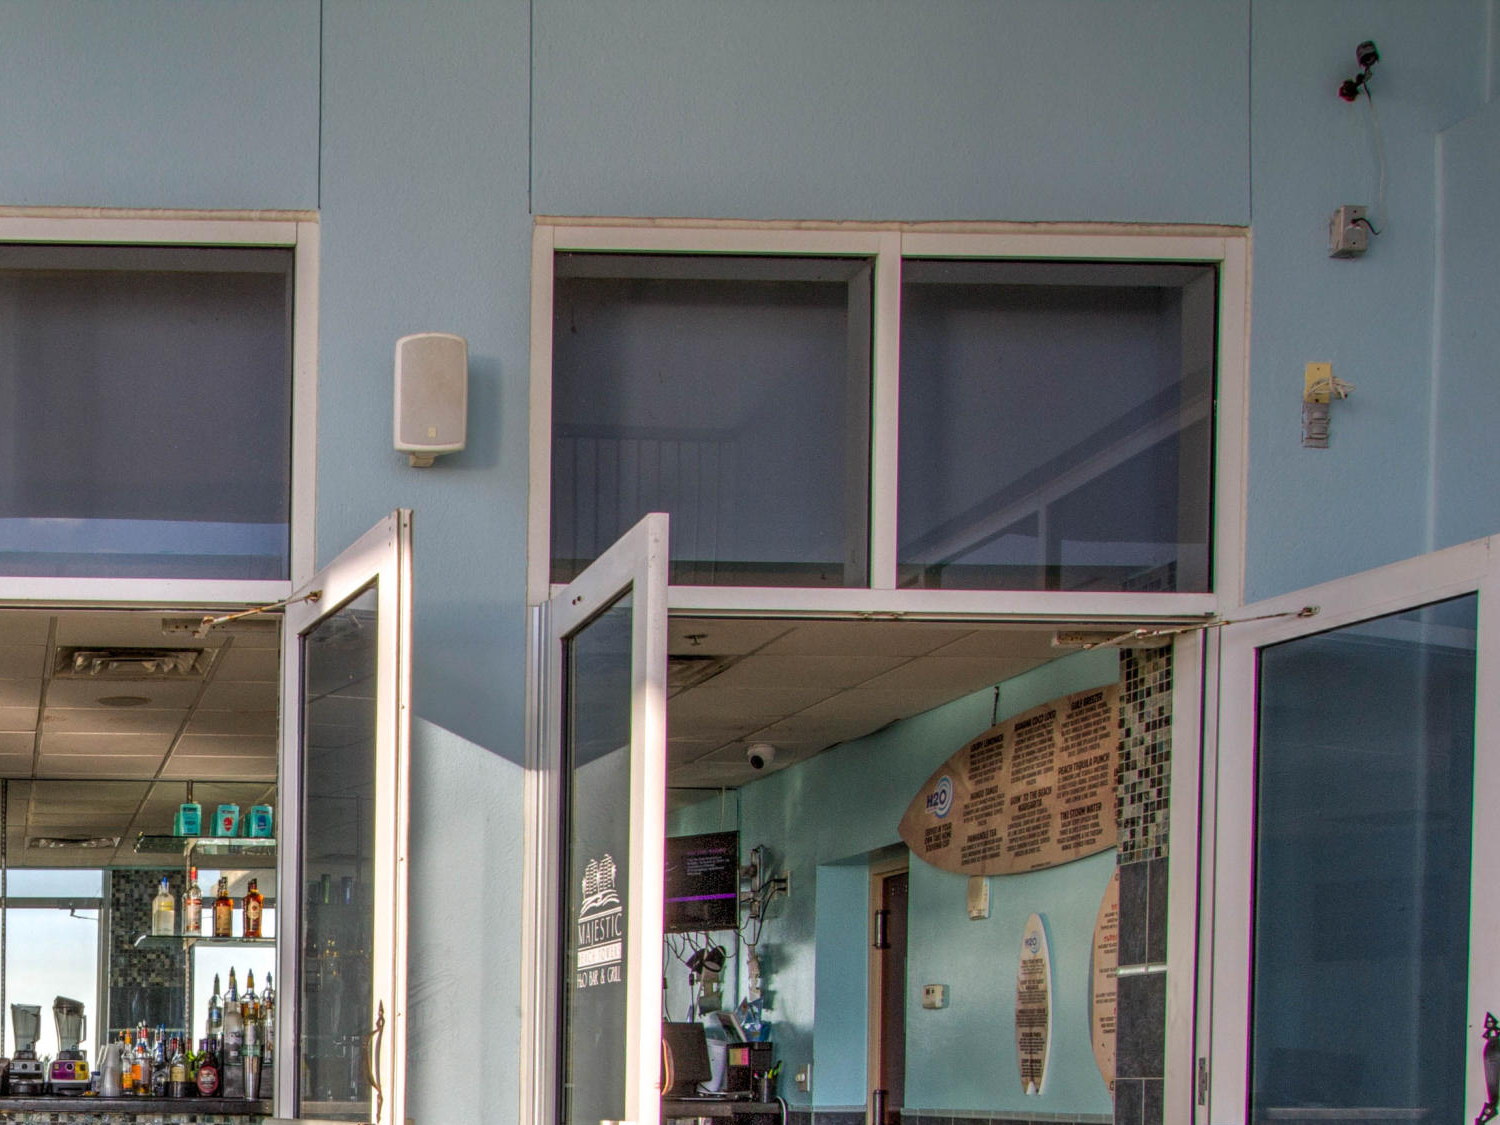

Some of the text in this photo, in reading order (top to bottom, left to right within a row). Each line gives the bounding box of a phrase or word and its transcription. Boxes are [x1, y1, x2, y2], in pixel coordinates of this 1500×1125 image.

[926, 790, 947, 809] H2O
[578, 913, 622, 946] MAJESTIC
[589, 968, 598, 986] BAR
[607, 965, 622, 983] GRILL
